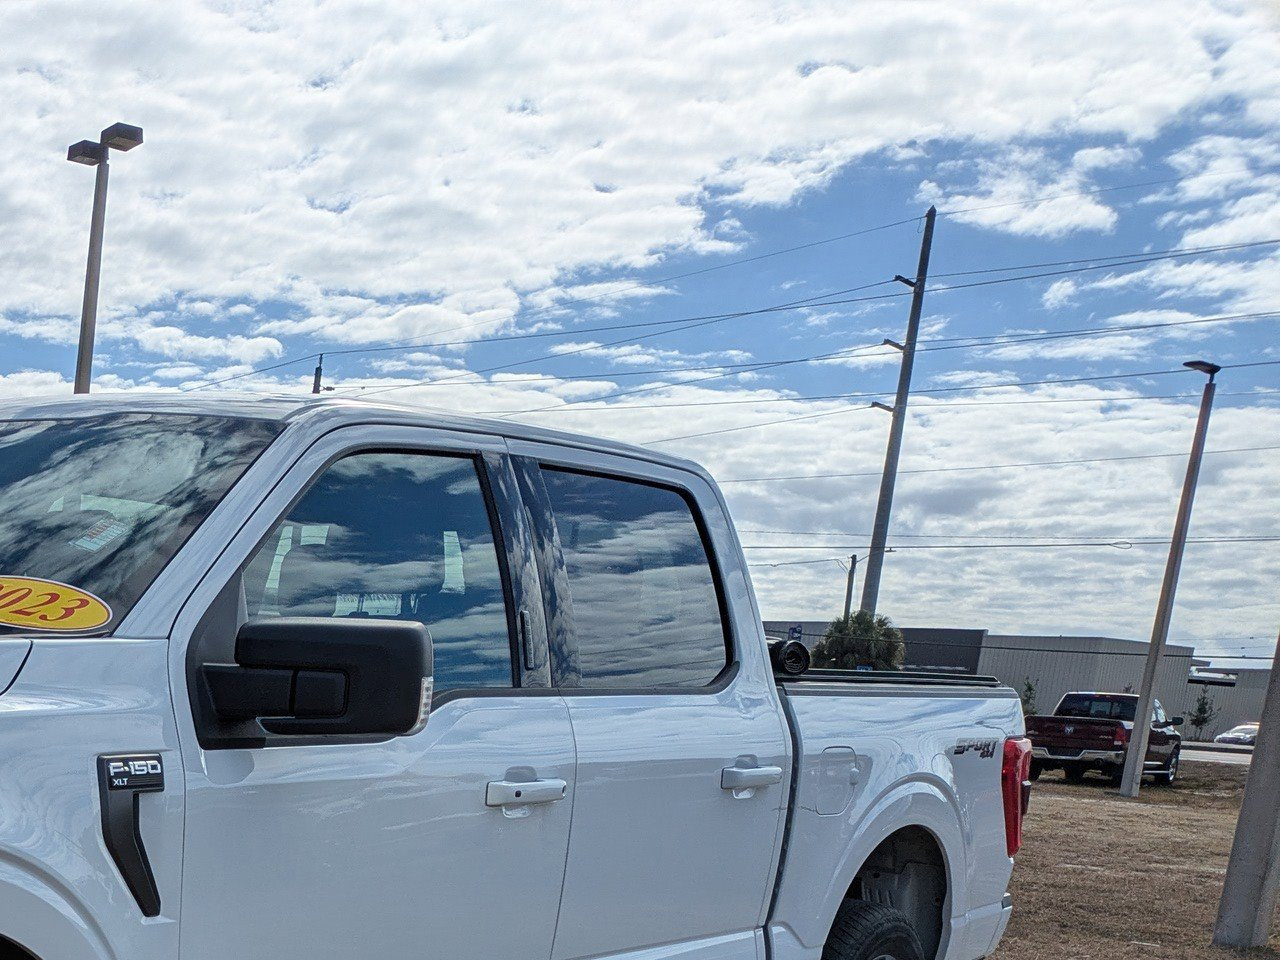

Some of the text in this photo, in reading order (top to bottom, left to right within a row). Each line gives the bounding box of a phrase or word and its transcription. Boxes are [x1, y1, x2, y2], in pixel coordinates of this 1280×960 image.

[953, 737, 999, 755] SPORT
[109, 760, 161, 776] F-150
[112, 777, 128, 786] XLT
